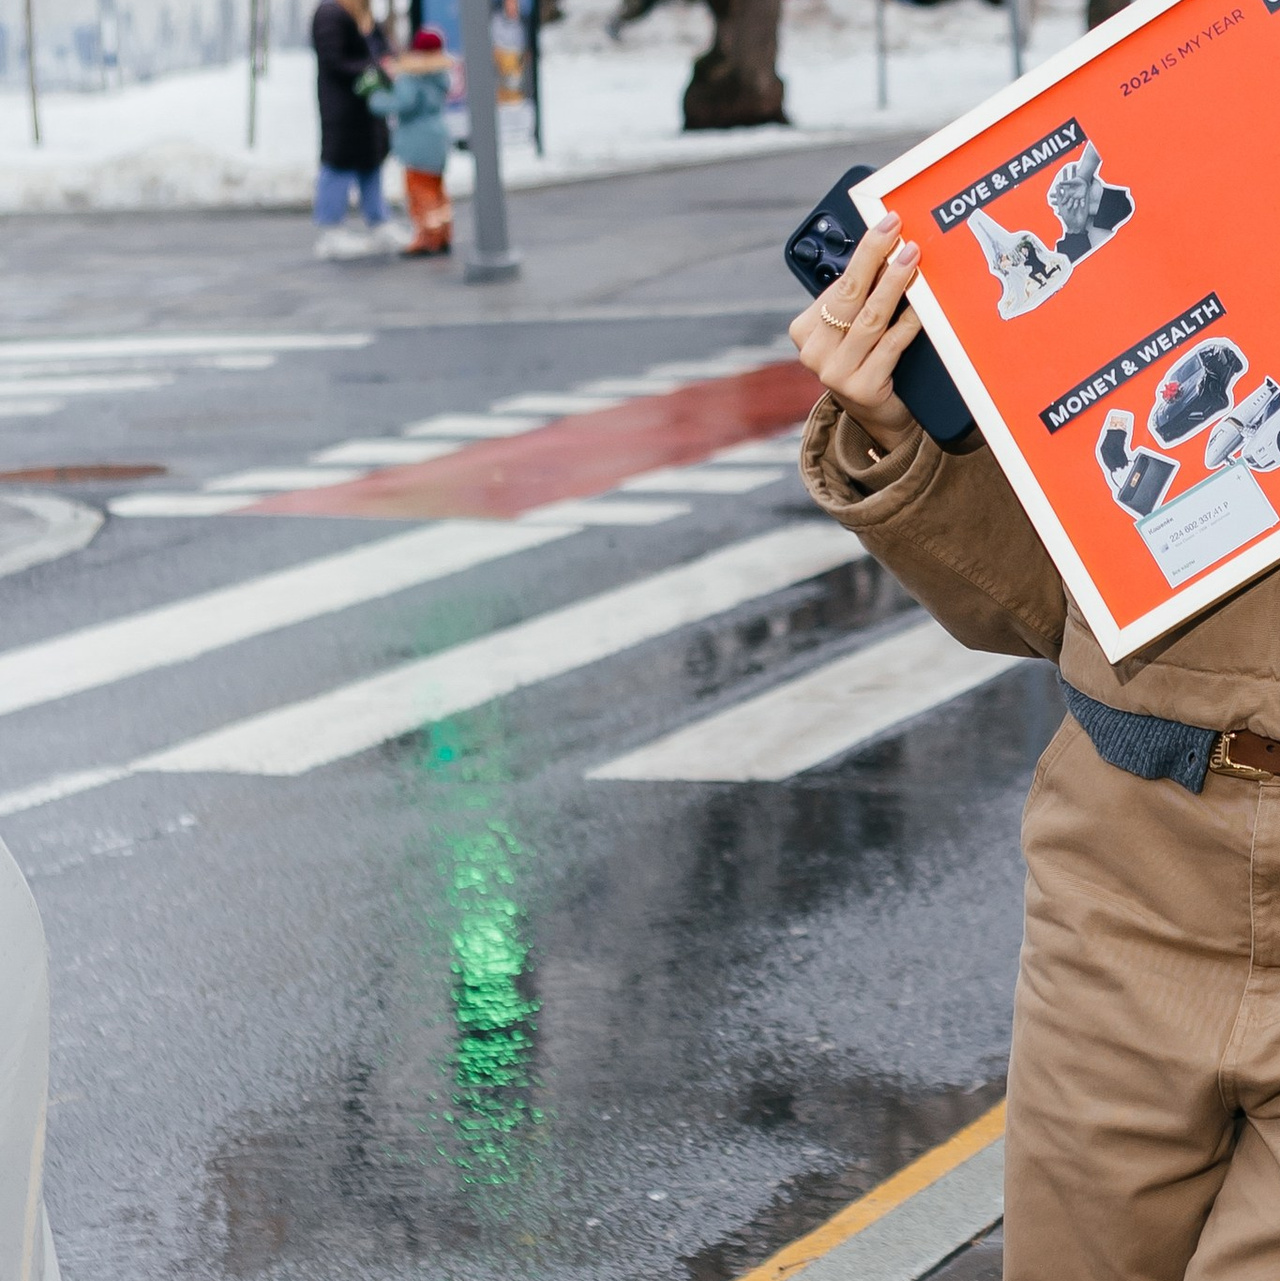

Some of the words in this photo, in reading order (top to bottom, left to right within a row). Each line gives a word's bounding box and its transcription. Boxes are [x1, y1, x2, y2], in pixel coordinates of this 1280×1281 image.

[1120, 64, 1160, 97] 2024
[1160, 53, 1177, 70] IS
[1177, 35, 1202, 60] MY
[1202, 8, 1245, 41] YEAR
[939, 182, 992, 225] LOVE
[991, 173, 1009, 190] &
[1008, 124, 1078, 178] FAMILY
[1048, 369, 1117, 427] MONEY
[1120, 359, 1138, 376] &
[1137, 299, 1220, 363] WEALTH
